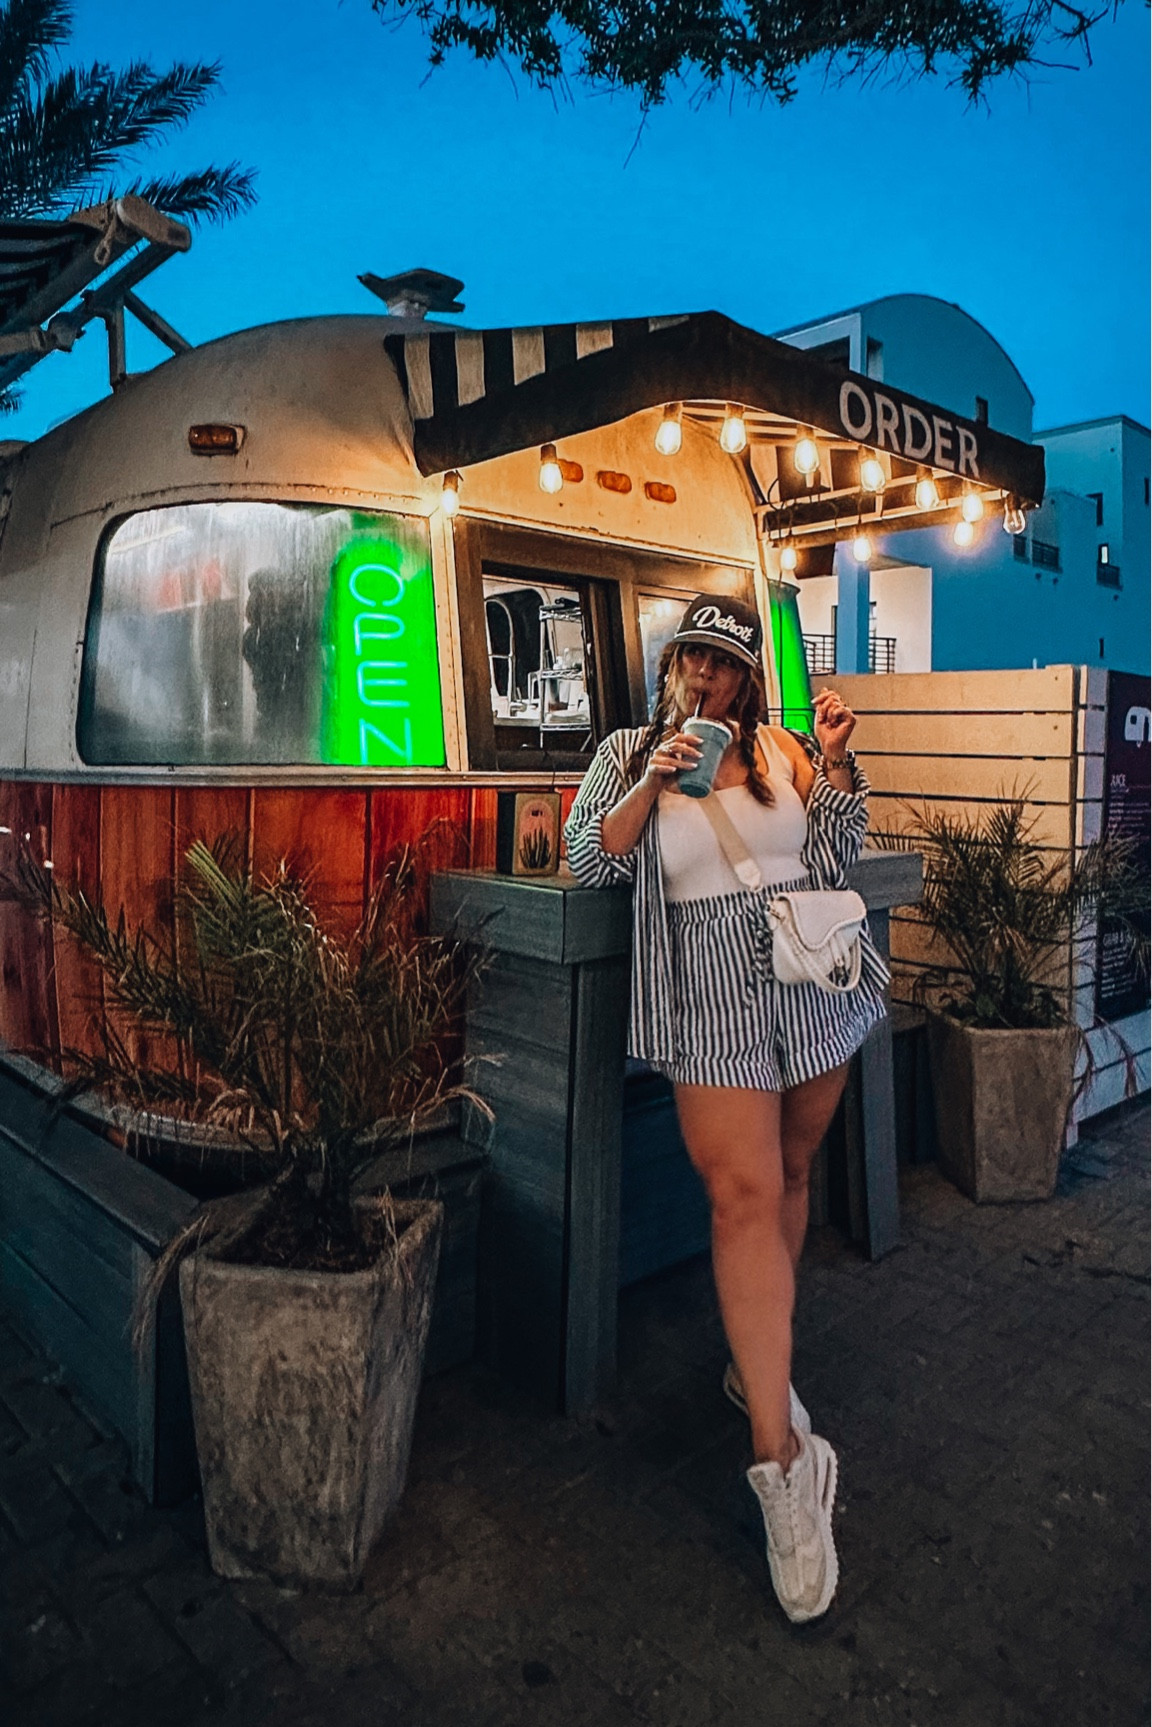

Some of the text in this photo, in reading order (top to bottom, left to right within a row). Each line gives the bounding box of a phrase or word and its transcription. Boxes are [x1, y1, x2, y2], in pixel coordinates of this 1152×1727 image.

[839, 380, 980, 479] ORDER
[349, 563, 413, 765] OPEN
[692, 605, 754, 643] Detroit
